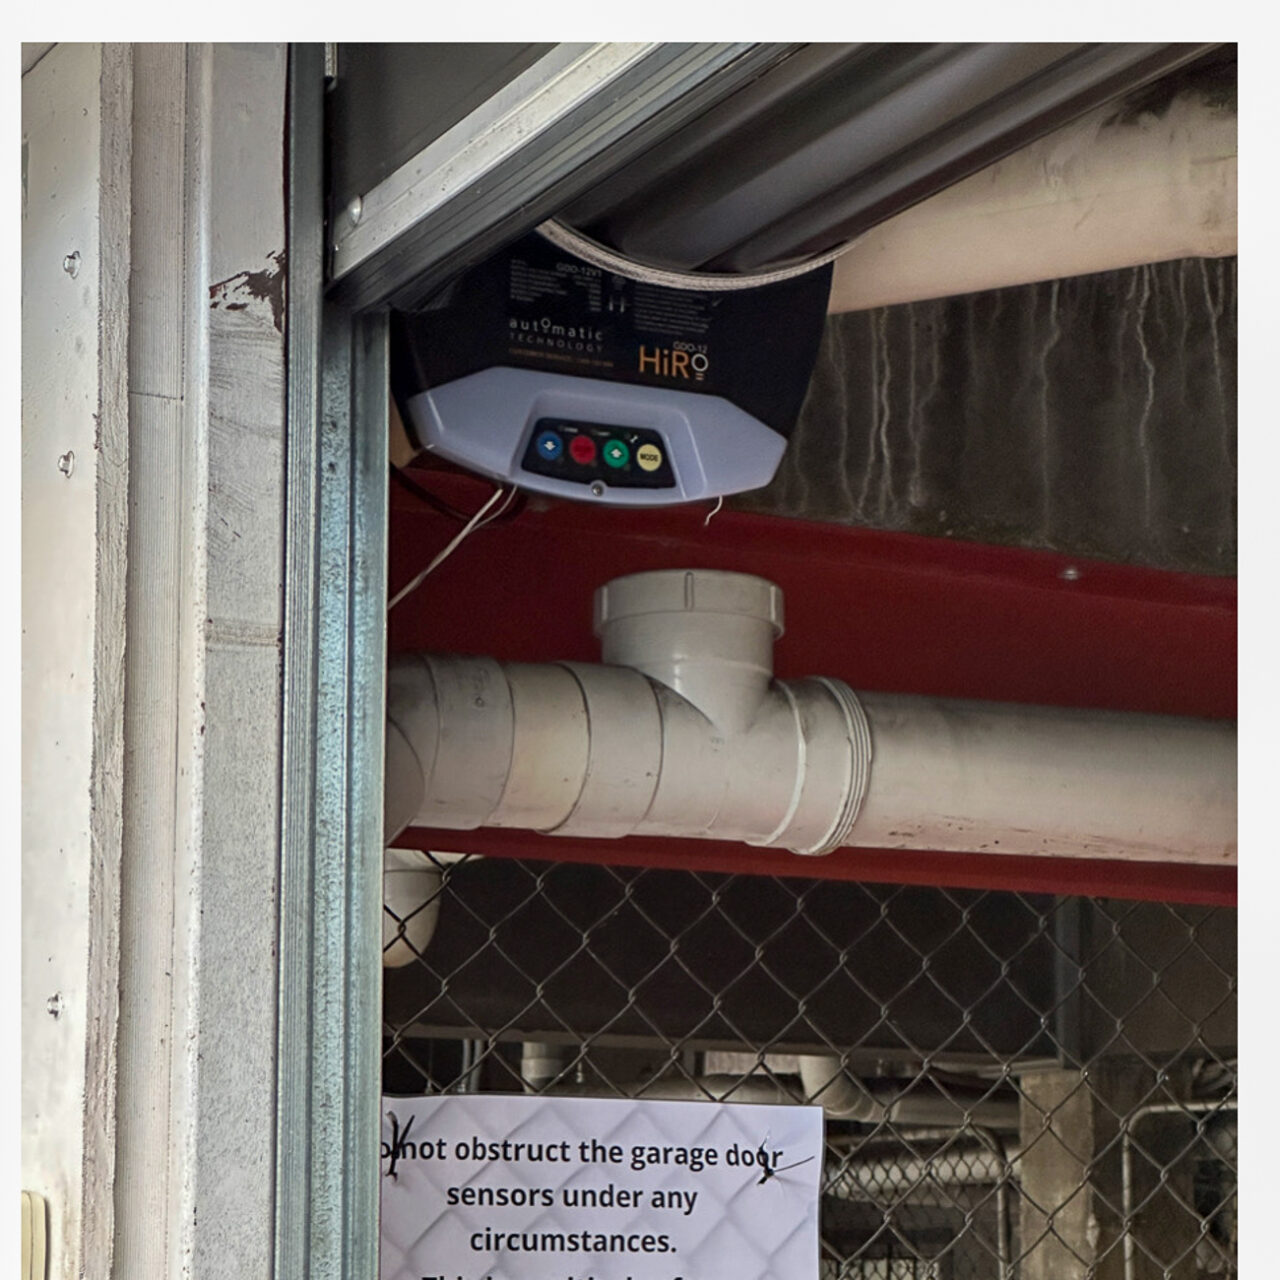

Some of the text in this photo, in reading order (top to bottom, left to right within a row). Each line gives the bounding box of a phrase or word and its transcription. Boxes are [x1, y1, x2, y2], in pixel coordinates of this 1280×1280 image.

[510, 318, 603, 341] automatic
[509, 332, 603, 353] TECHNOLOGY
[640, 452, 658, 462] MODE
[400, 1138, 448, 1160] not
[455, 1137, 570, 1162] obstruct
[579, 1139, 623, 1163] the
[631, 1147, 717, 1172] garage
[725, 1144, 784, 1168] door
[447, 1184, 697, 1215] sensors under any
[471, 1227, 676, 1252] circumstances.
